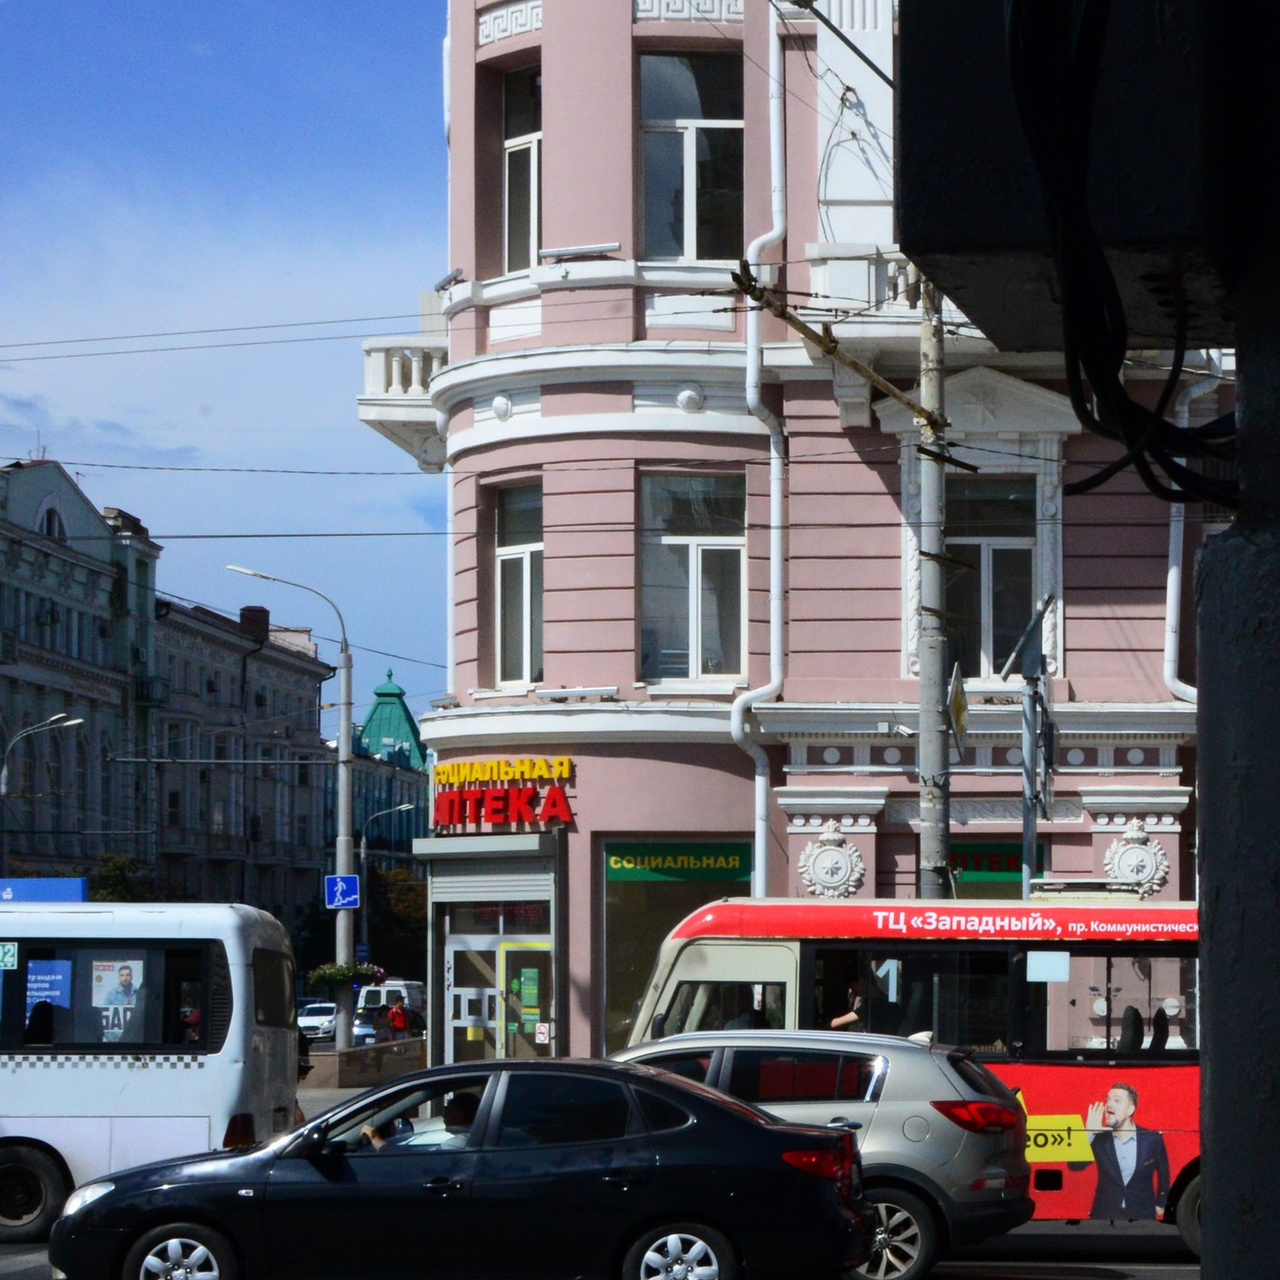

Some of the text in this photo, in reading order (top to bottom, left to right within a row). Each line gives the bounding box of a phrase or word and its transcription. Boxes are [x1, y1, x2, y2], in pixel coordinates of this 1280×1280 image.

[434, 756, 573, 786] СОЦИАЛЬНАЯ
[433, 786, 573, 825] АПТЕКА
[609, 855, 740, 871] СОЦИАЛЬНАЯ
[873, 911, 907, 933] ТЦ
[910, 912, 1063, 935] «Западный»,
[1068, 922, 1088, 934] пр.
[0, 944, 15, 962] 2
